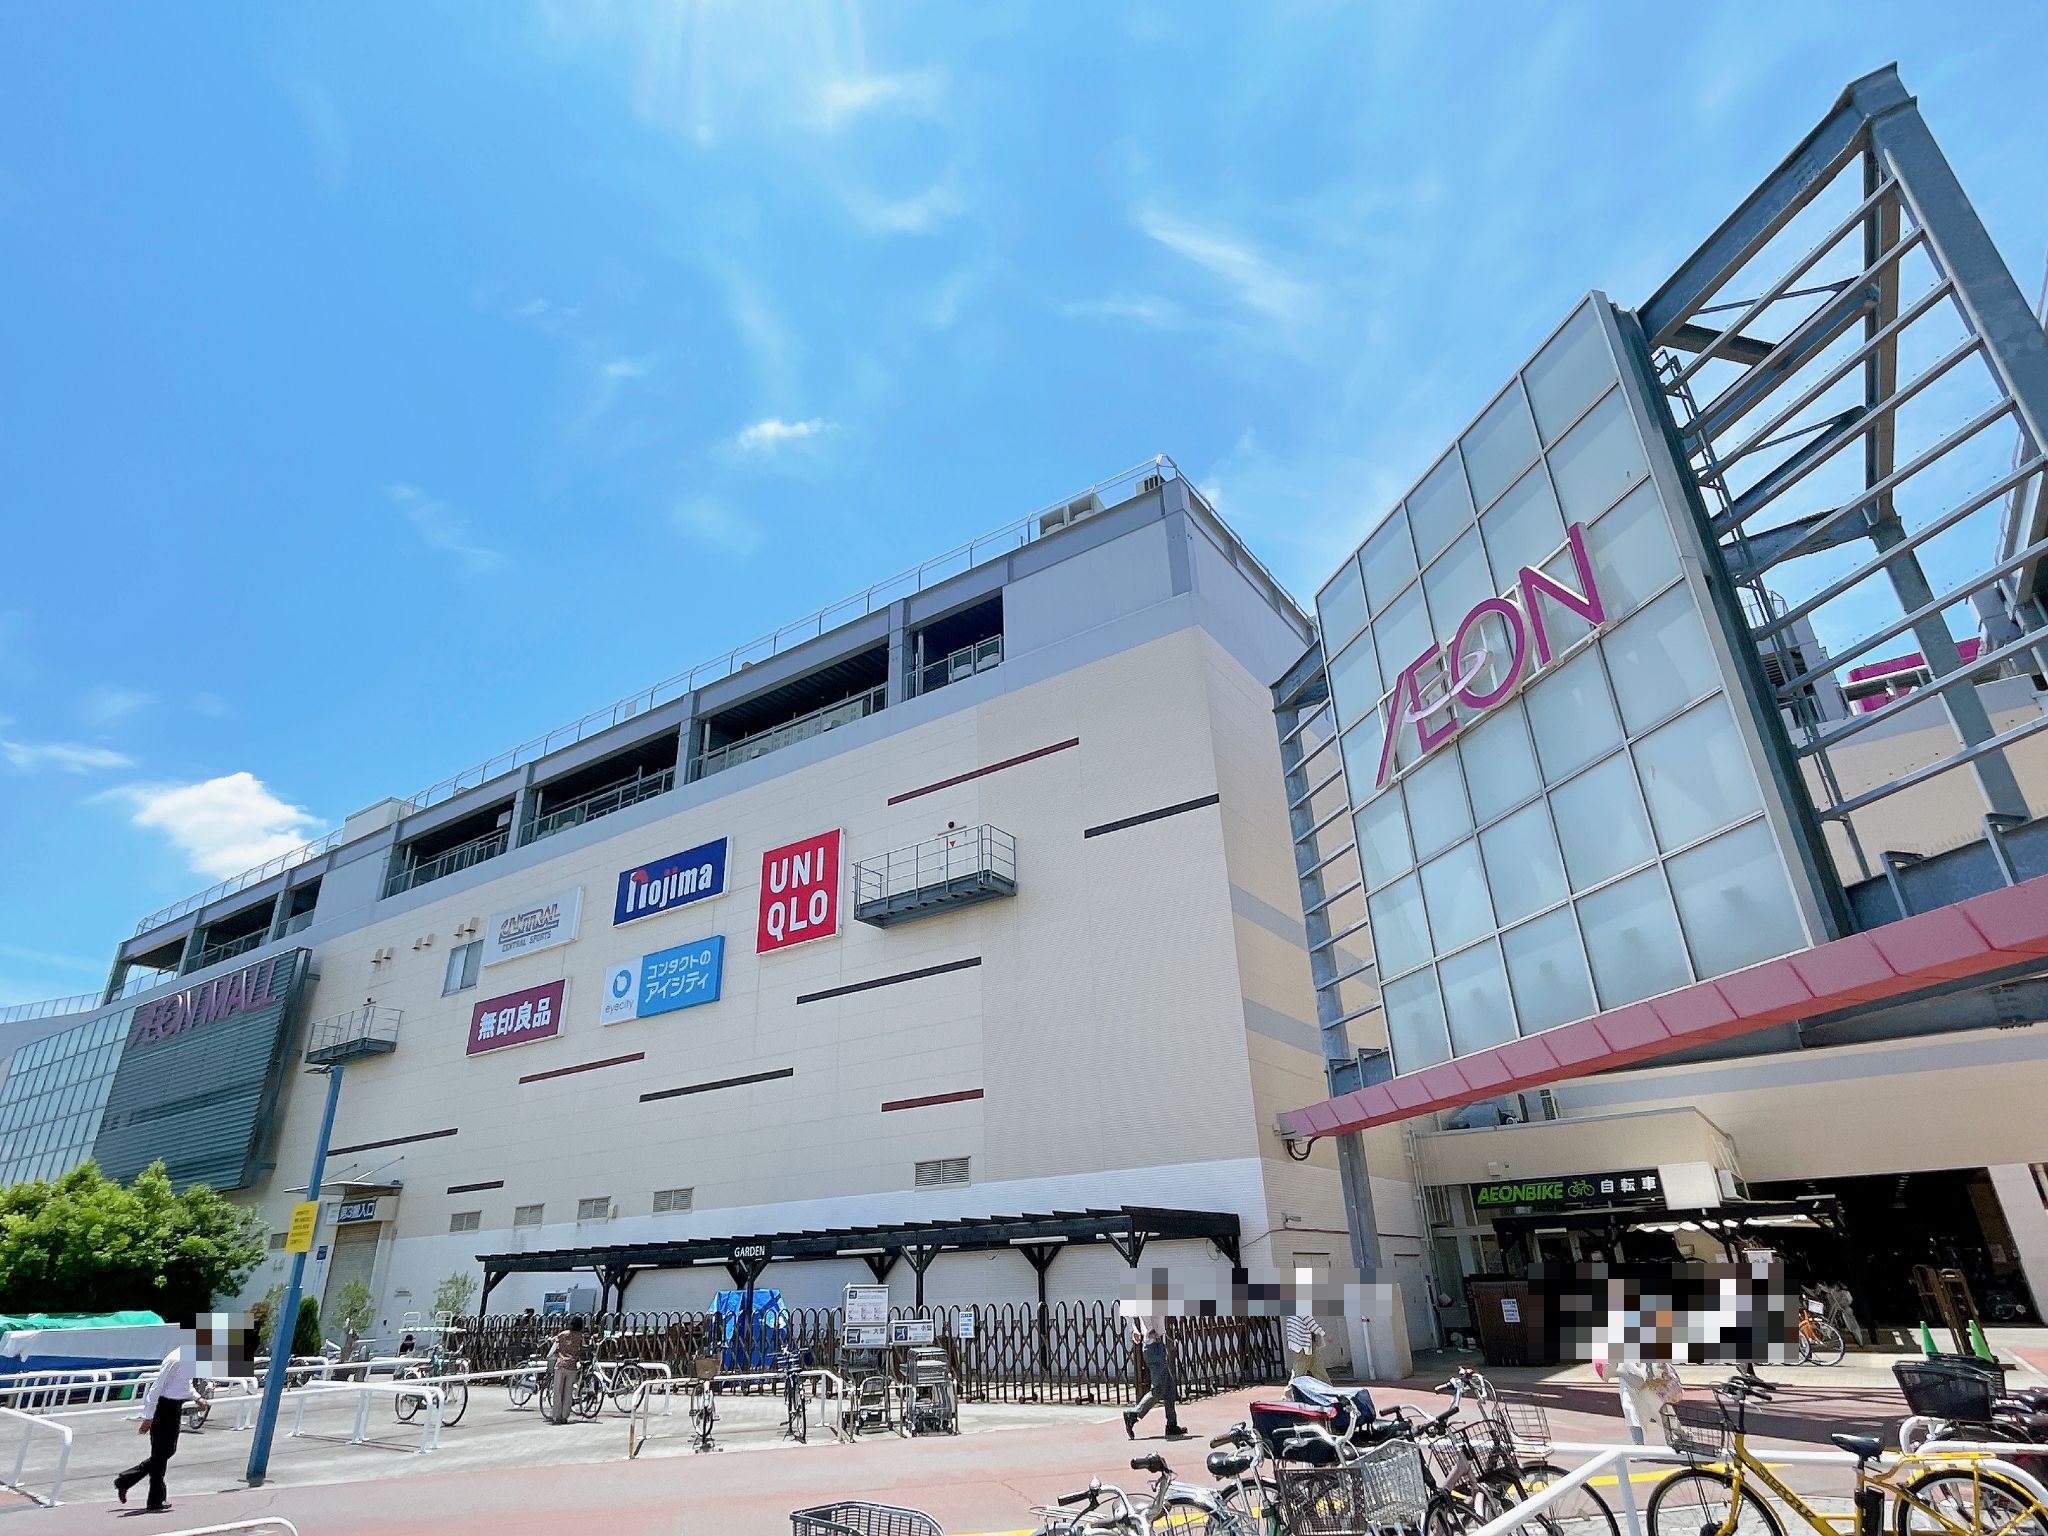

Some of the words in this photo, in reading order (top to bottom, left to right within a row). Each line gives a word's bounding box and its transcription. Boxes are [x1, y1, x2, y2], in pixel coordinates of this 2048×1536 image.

[769, 847, 825, 894] UNI
[626, 862, 713, 914] nojima
[767, 889, 828, 941] QLO
[502, 939, 526, 953] CENTRAL
[529, 931, 552, 944] SPORTS
[647, 949, 712, 980] コンタクトの
[204, 957, 276, 1024] MALL
[645, 970, 710, 1003] アイシティ
[477, 996, 552, 1042] 無印良品
[605, 1000, 634, 1015] eyecity
[1478, 1181, 1564, 1204] AEONBIKE
[1600, 1175, 1657, 1194] 自転車
[734, 1245, 765, 1258] GARDEN
